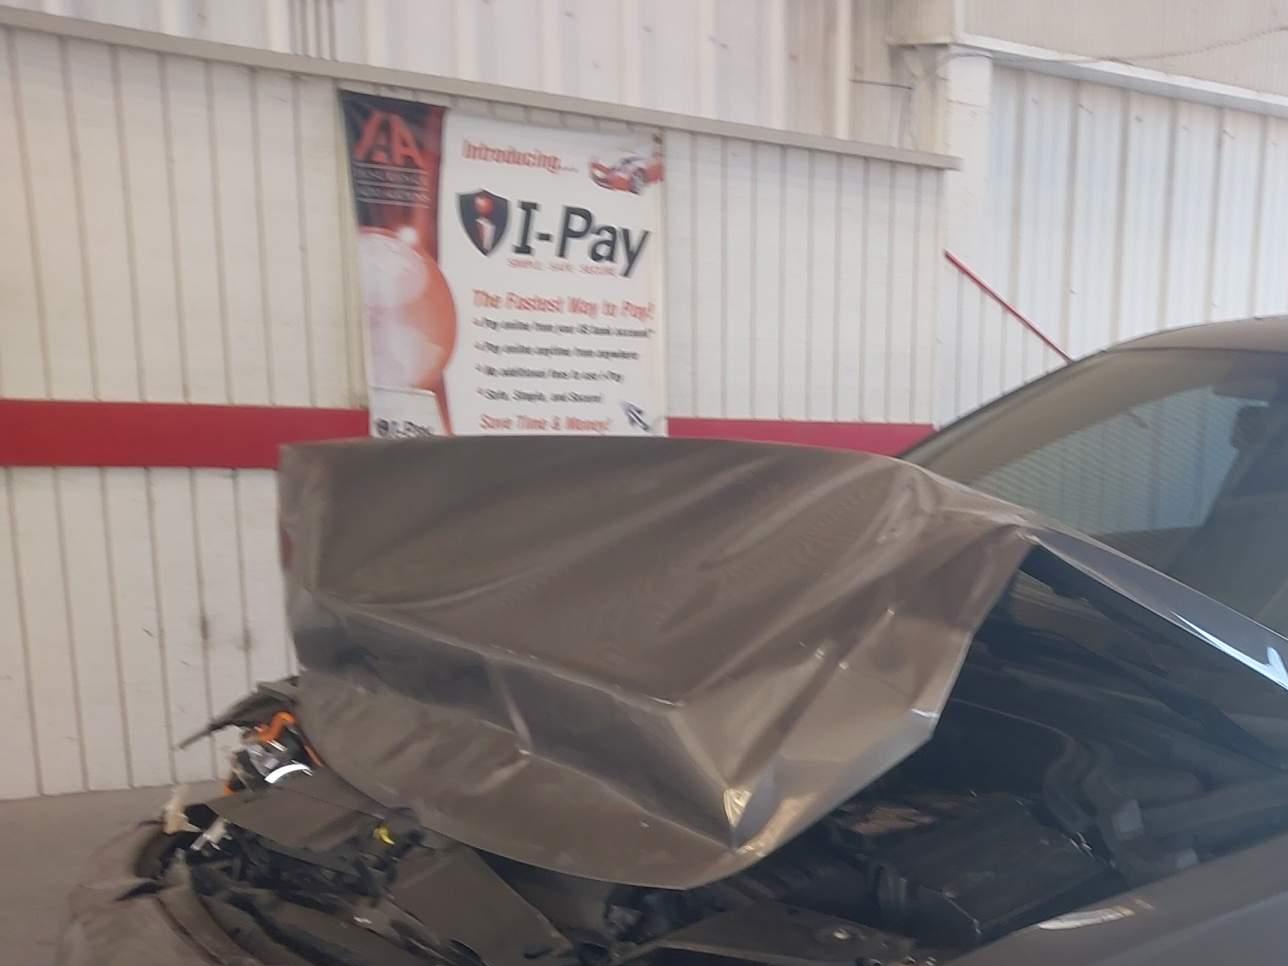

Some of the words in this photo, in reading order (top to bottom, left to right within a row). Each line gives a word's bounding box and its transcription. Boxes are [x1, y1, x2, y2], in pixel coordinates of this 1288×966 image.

[513, 200, 650, 277] I-Pay
[473, 289, 500, 308] The
[506, 292, 562, 312] Fastest
[568, 296, 597, 317] Way
[602, 302, 617, 316] to
[480, 414, 512, 430] Save
[516, 415, 546, 430] Time
[551, 415, 561, 430] &
